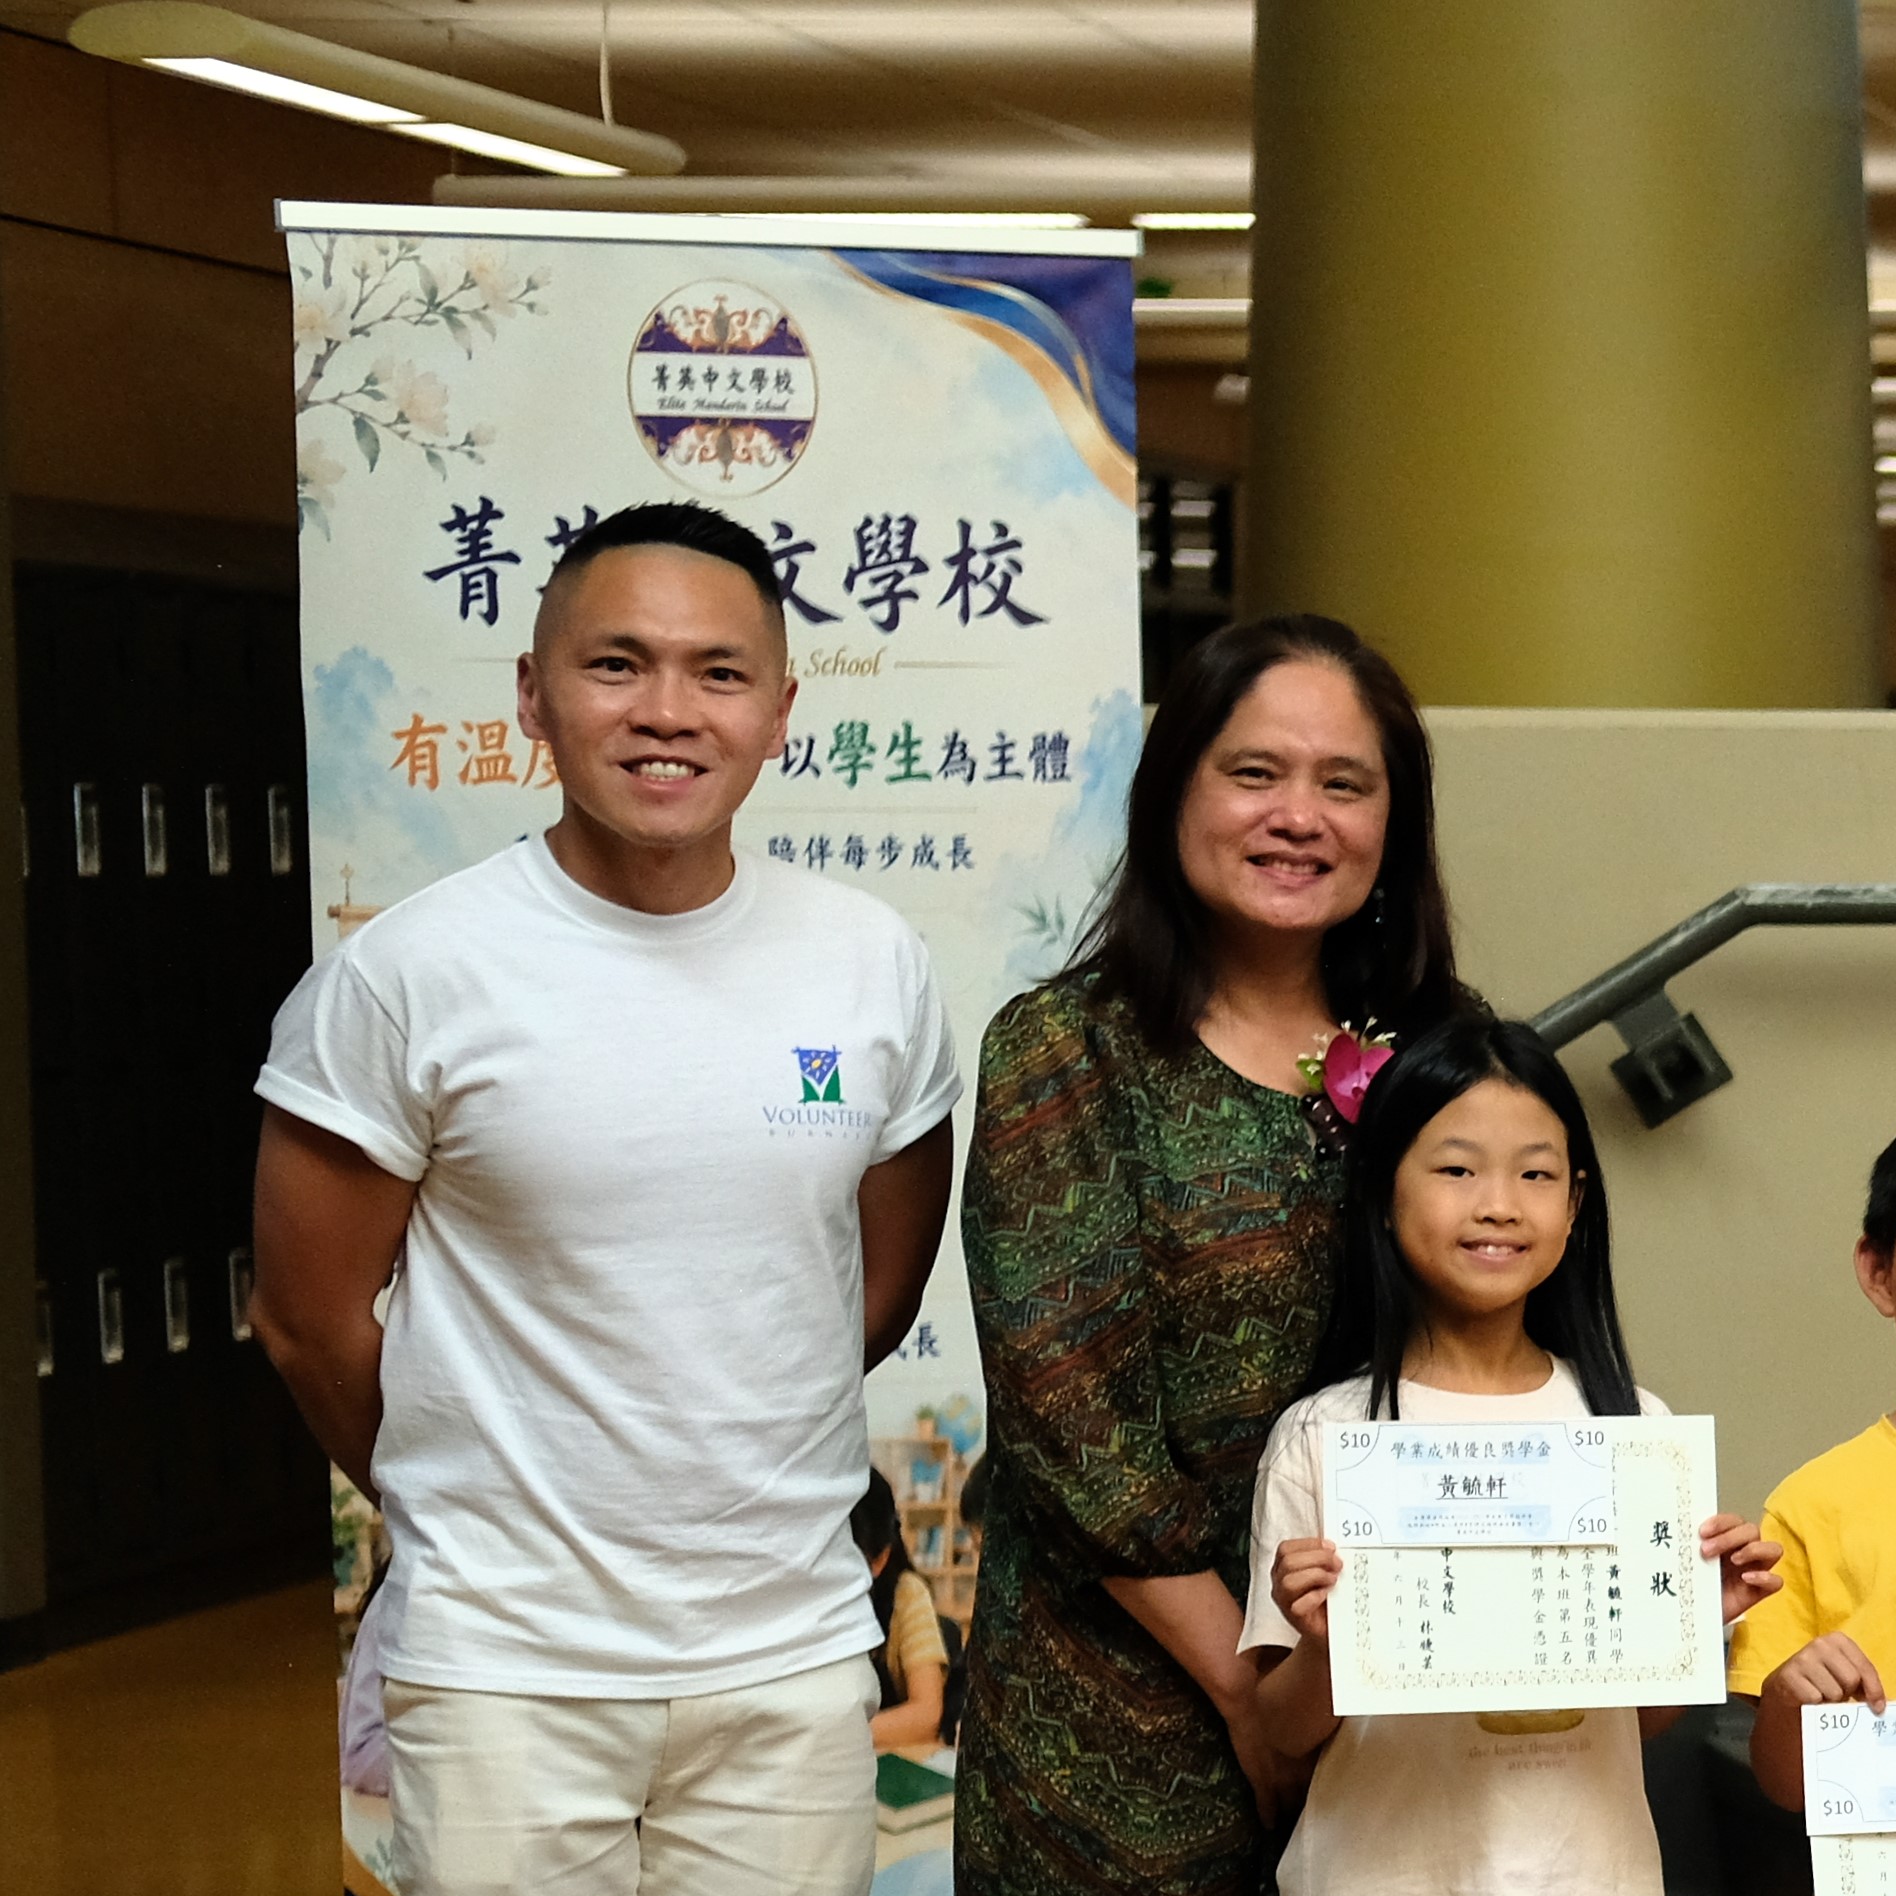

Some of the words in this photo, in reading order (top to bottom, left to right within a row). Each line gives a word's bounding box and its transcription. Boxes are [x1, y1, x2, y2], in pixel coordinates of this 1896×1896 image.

[653, 362, 795, 395] 菁英中文學校
[805, 647, 882, 678] School
[780, 718, 1073, 790] 以學生為主體
[763, 1105, 872, 1128] VOLUNTEER
[1340, 1432, 1370, 1448] $10
[1575, 1430, 1604, 1447] $10
[1391, 1441, 1551, 1460] 學業成績優良獎學金
[1342, 1520, 1373, 1536] $10
[1577, 1518, 1607, 1534] $10
[1650, 1520, 1677, 1598] 獎狀
[1820, 1714, 1849, 1730] $10
[1823, 1799, 1854, 1816] $10
